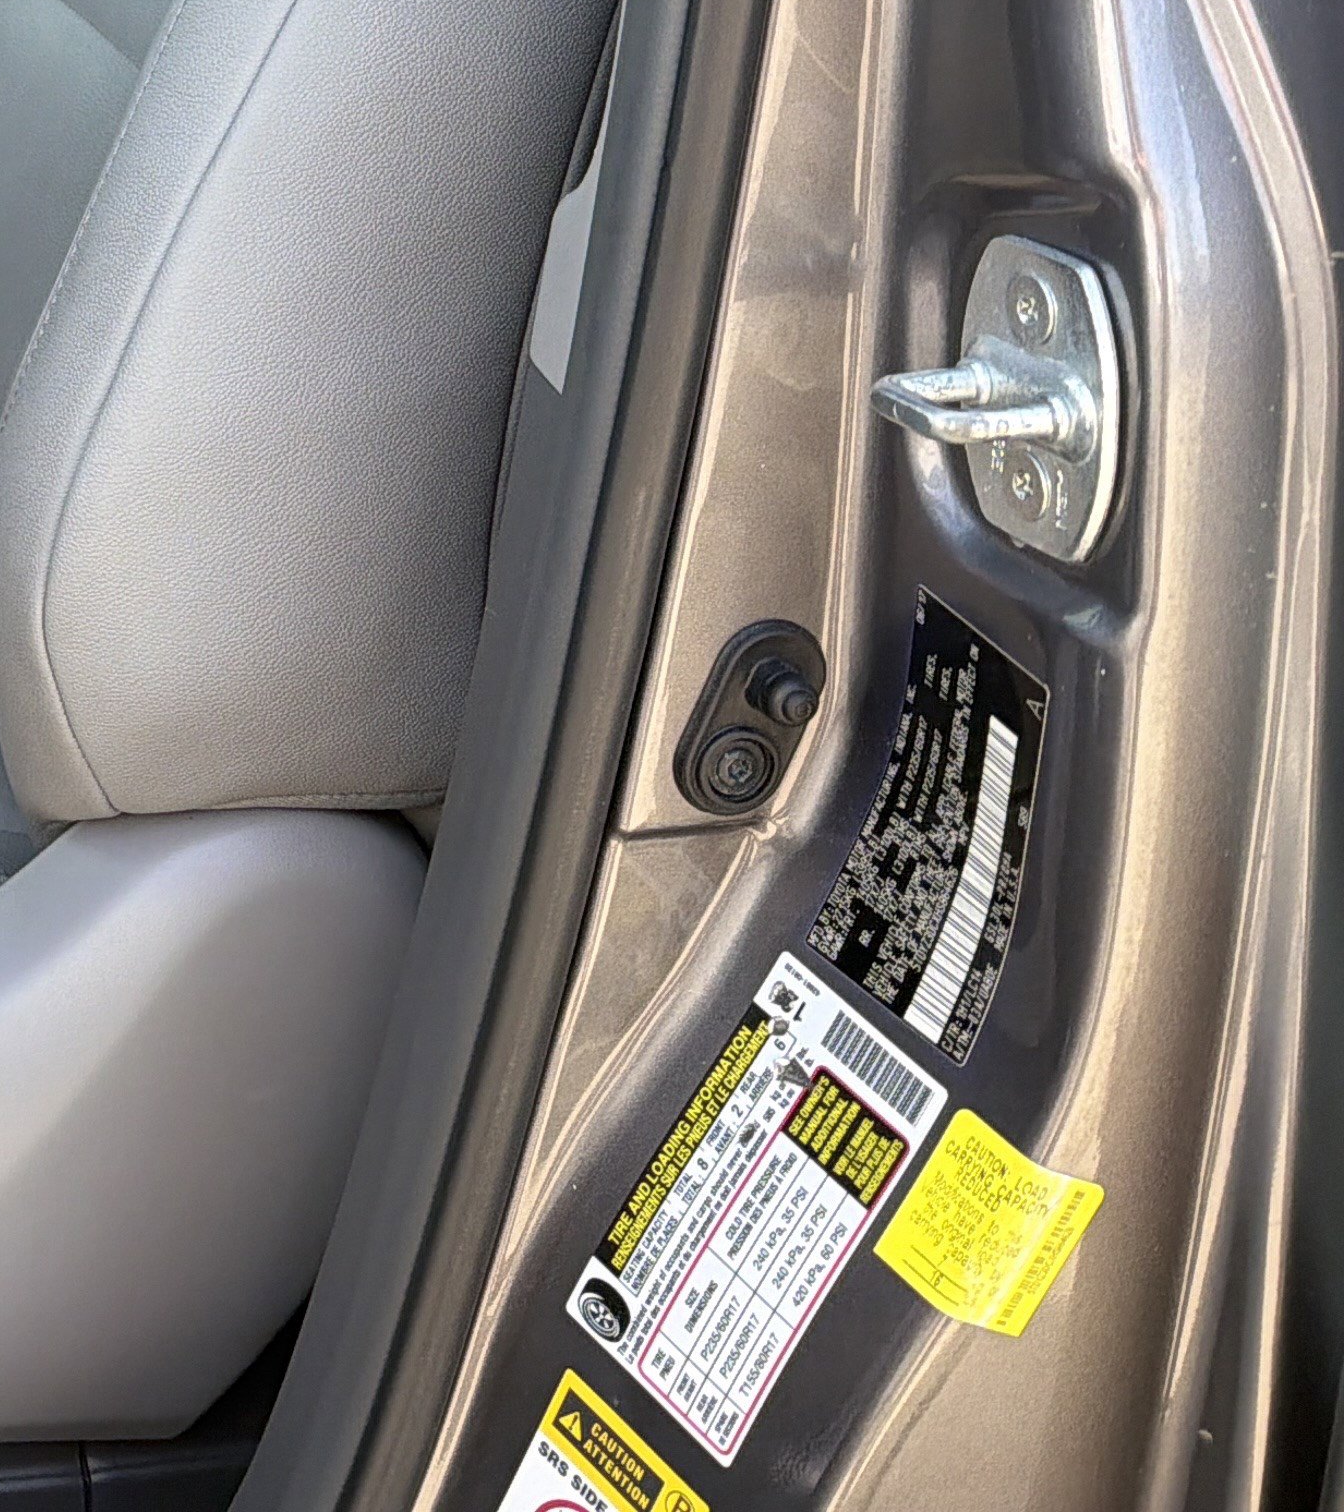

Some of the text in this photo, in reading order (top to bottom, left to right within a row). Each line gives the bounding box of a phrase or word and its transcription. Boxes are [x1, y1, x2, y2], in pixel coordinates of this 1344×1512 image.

[1025, 691, 1044, 721] A
[871, 952, 899, 998] VEHICLE
[894, 909, 918, 951] SAFETY
[913, 885, 928, 911] AND
[969, 642, 979, 663] ON
[893, 777, 913, 811] WITH
[911, 791, 928, 824] WITH
[844, 838, 866, 872] MOTOR
[862, 961, 883, 990] THIS
[876, 913, 904, 964] VEHICLE
[881, 981, 898, 1005] THE
[891, 952, 911, 983] DATE
[905, 934, 920, 953] OF
[607, 1210, 633, 1247] TIRE
[626, 1180, 652, 1215] AND
[645, 1118, 691, 1185] LOADING
[684, 1024, 752, 1123] INFORMATION
[788, 1074, 830, 1136] SEE OWNER'S
[798, 1084, 839, 1144] MANUAL FOR
[810, 1096, 848, 1152] ADDITIONAL
[818, 1101, 861, 1165] INFORMATION
[610, 1019, 772, 1270] RENSEIGNEMENTS SUR LES PNEUS ET LE CHARGEMENT
[621, 1247, 646, 1283] SEATING
[641, 1208, 669, 1250] CAPACITY
[673, 1170, 693, 1198] TOTAL
[695, 1156, 709, 1172] 8
[705, 1118, 726, 1147] FRONT
[730, 1102, 744, 1118] 2
[738, 1069, 757, 1094] REAR
[773, 1036, 786, 1052] 6
[833, 1116, 873, 1176] VOIR LE MANUEL
[845, 1131, 879, 1179] DE L'USAGER
[854, 1136, 890, 1190] POUR PLUS DE
[859, 1138, 903, 1205] RENSEIGNEMENTS
[963, 1135, 1049, 1202] CAUTION: LOAD
[724, 1153, 783, 1241] COLD TIRE PRESSURE
[726, 1221, 753, 1261] PRESSION
[748, 1206, 763, 1224] DES
[758, 1180, 779, 1209] PNEUS
[778, 1151, 798, 1178] FROID
[943, 1139, 1050, 1218] CARRYING CAPACITY
[952, 1166, 1003, 1214] REDUCED
[630, 1255, 654, 1291] NOMBRE
[650, 1244, 661, 1258] DE
[656, 1215, 678, 1247] PLACES
[751, 1185, 808, 1272] 240 kPa, 35 PSI
[771, 1202, 828, 1290] 240 kPa, 35 PSI
[616, 1339, 629, 1357] The
[623, 1304, 648, 1342] combined
[643, 1278, 664, 1308] weight
[658, 1269, 668, 1281] of
[686, 1217, 699, 1234] and
[696, 1195, 715, 1221] cargo
[709, 1168, 729, 1197] should
[790, 1221, 848, 1309] 420 kPa, 60 PSI
[683, 1278, 719, 1334] DIMENSIONS
[684, 1286, 700, 1308] SIZE
[699, 1294, 742, 1361] P235/60R17
[650, 1347, 666, 1371] TIRE
[659, 1355, 676, 1381] PNEU
[718, 1312, 761, 1379] P235/60R17
[738, 1331, 781, 1398] T155/80R17
[538, 1441, 608, 1512] SRS SIDE
[583, 1440, 650, 1510] ATTENTION
[590, 1423, 644, 1481] CAUTION
